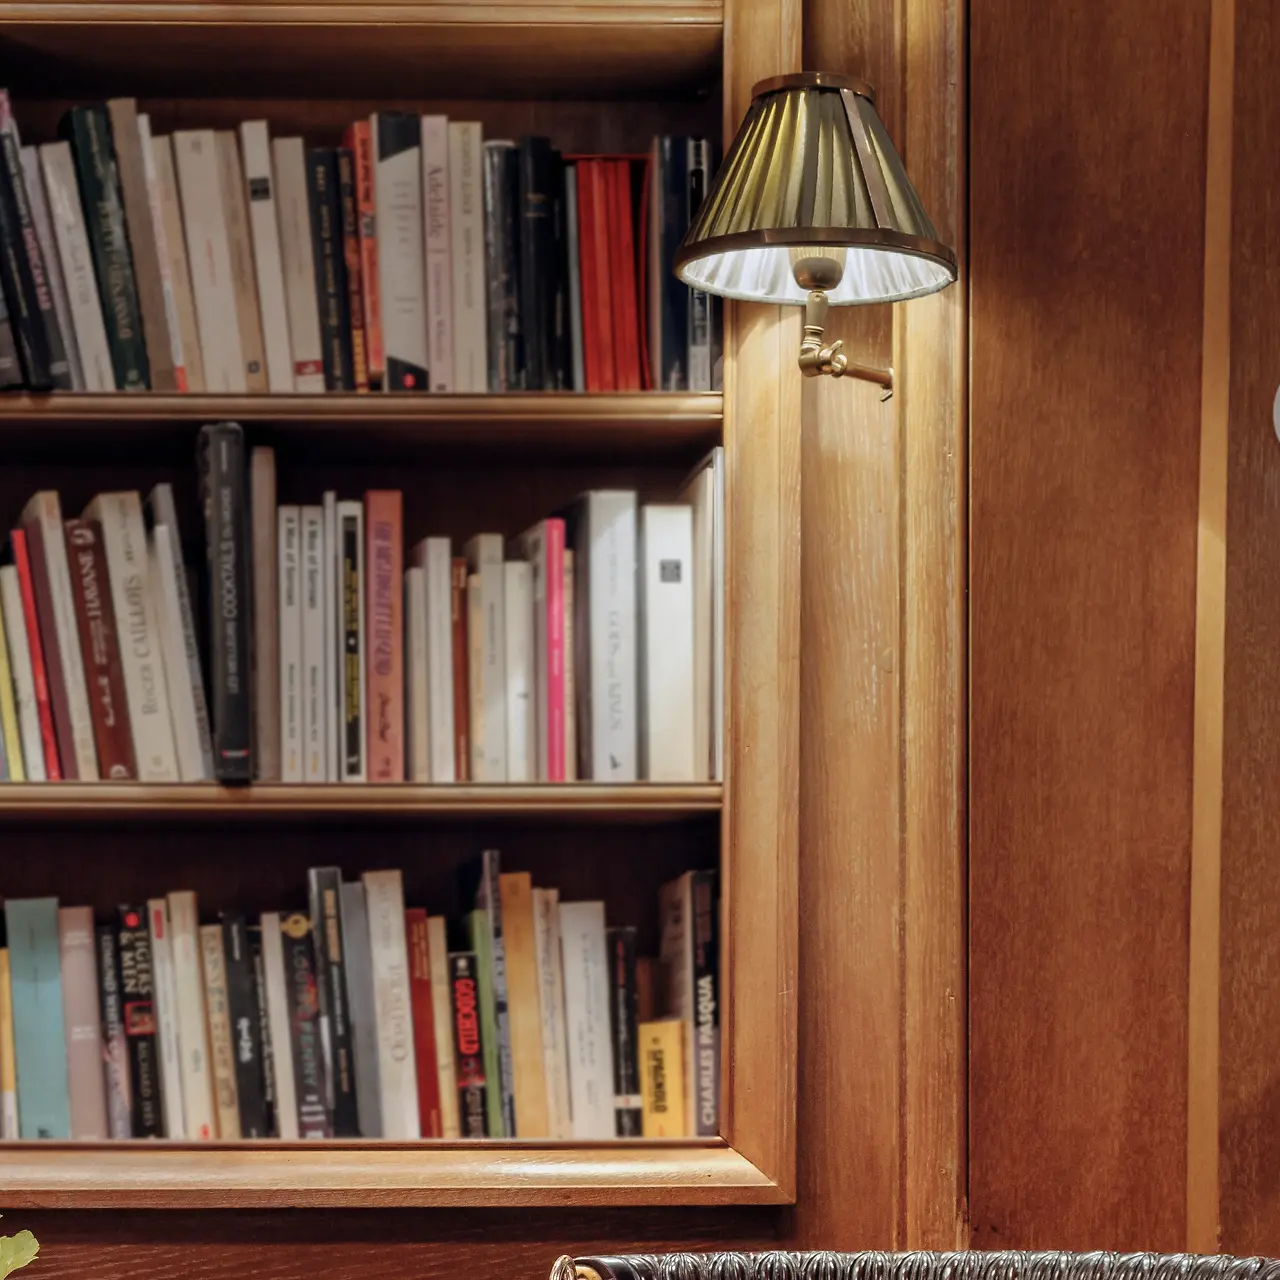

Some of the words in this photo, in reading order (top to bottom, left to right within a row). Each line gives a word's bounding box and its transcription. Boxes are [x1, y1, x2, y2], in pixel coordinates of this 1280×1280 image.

[427, 163, 446, 240] Adelaide
[22, 228, 44, 285] AMERICAN
[37, 286, 51, 311] BAR
[285, 527, 294, 549] Man
[285, 552, 295, 563] of
[308, 530, 317, 552] Man
[308, 555, 318, 566] of
[79, 550, 101, 616] HAVANE
[221, 541, 238, 618] COCKTAILS
[285, 566, 295, 607] Sorrows
[308, 568, 318, 609] Sorrows
[101, 935, 117, 992] EDMUND
[119, 932, 133, 946] &
[135, 930, 152, 994] TIGERS
[122, 951, 138, 994] MEN
[293, 945, 313, 1017] LOUISE
[105, 994, 120, 1036] WHITE
[454, 979, 477, 1055] GODCHILD
[698, 975, 715, 1044] PASQUA
[138, 1041, 151, 1096] RICHARD
[299, 1021, 317, 1087] PENNY
[700, 1050, 715, 1126] CHARLES
